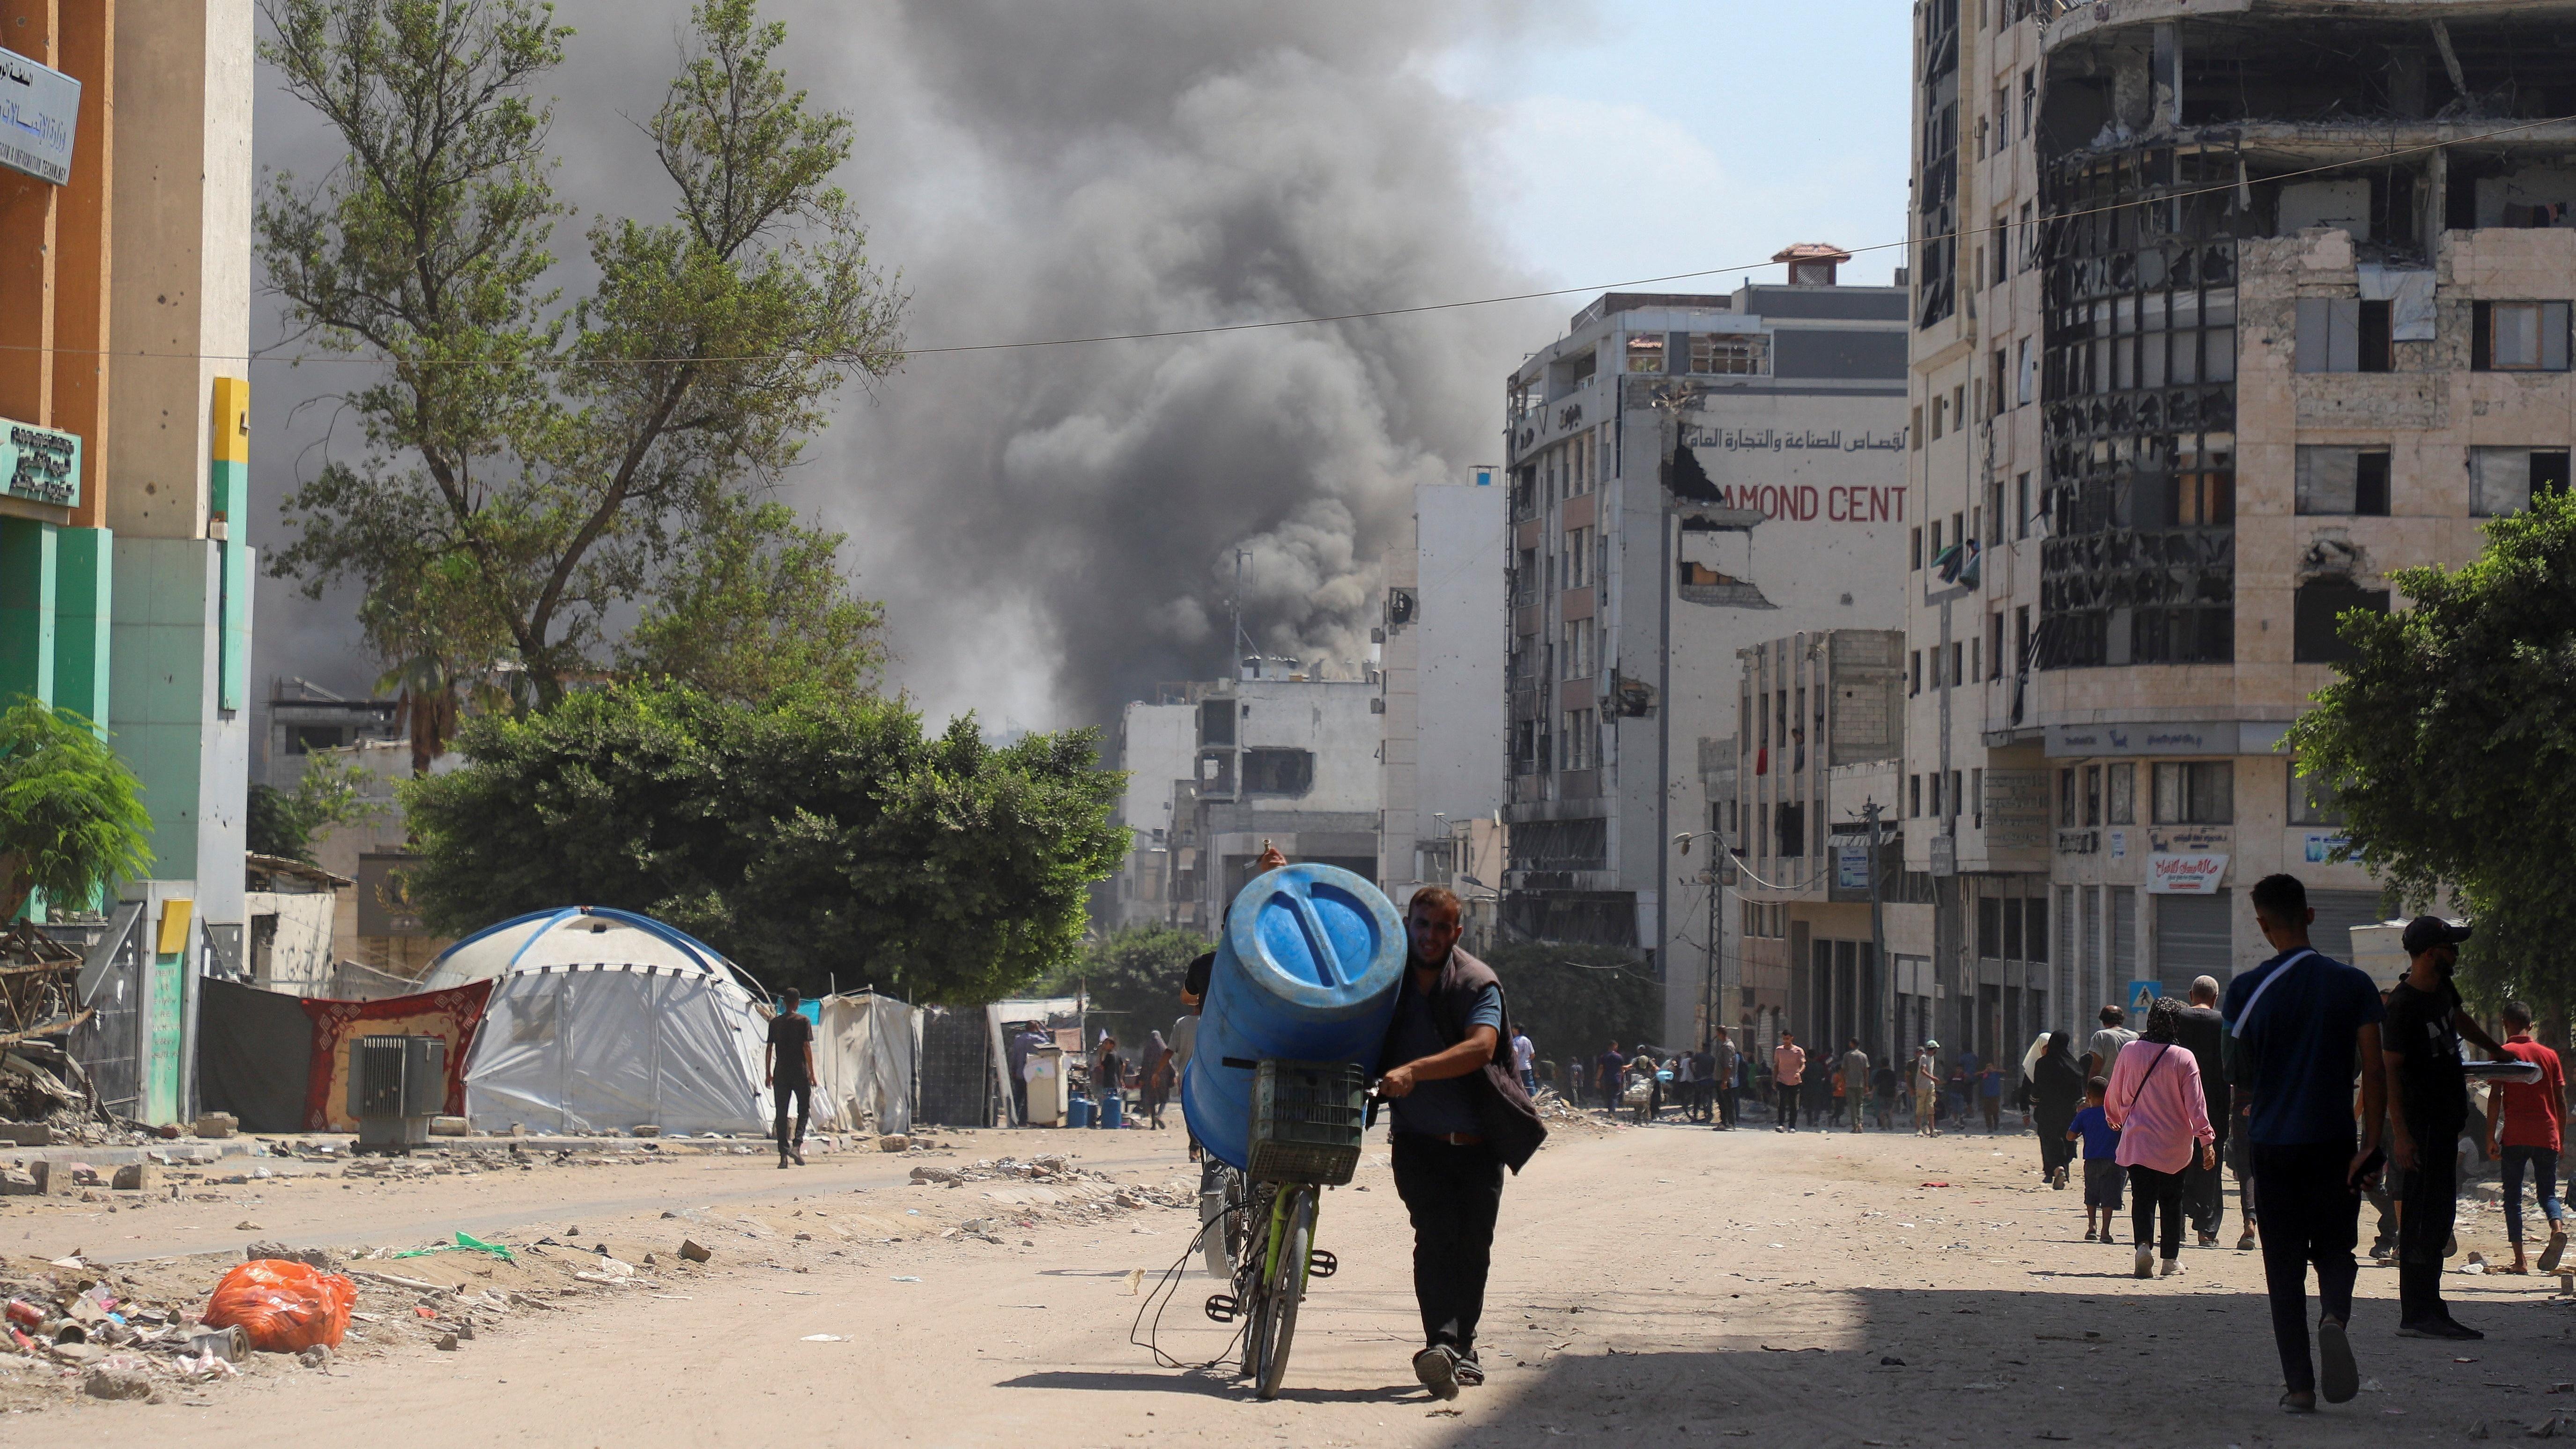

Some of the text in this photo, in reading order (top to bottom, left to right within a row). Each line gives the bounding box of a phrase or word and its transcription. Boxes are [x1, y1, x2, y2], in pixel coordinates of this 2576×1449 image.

[50, 118, 66, 153] وزارة
[14, 148, 42, 173] INFORMATION
[42, 160, 67, 182] TECHNOLOGY
[1725, 429, 1781, 452] والتجارة
[1785, 430, 1841, 450] للصناعة
[1844, 430, 1905, 452] لقصاص
[1724, 485, 1907, 522] AMOND CENT
[2198, 858, 2219, 875] صالة
